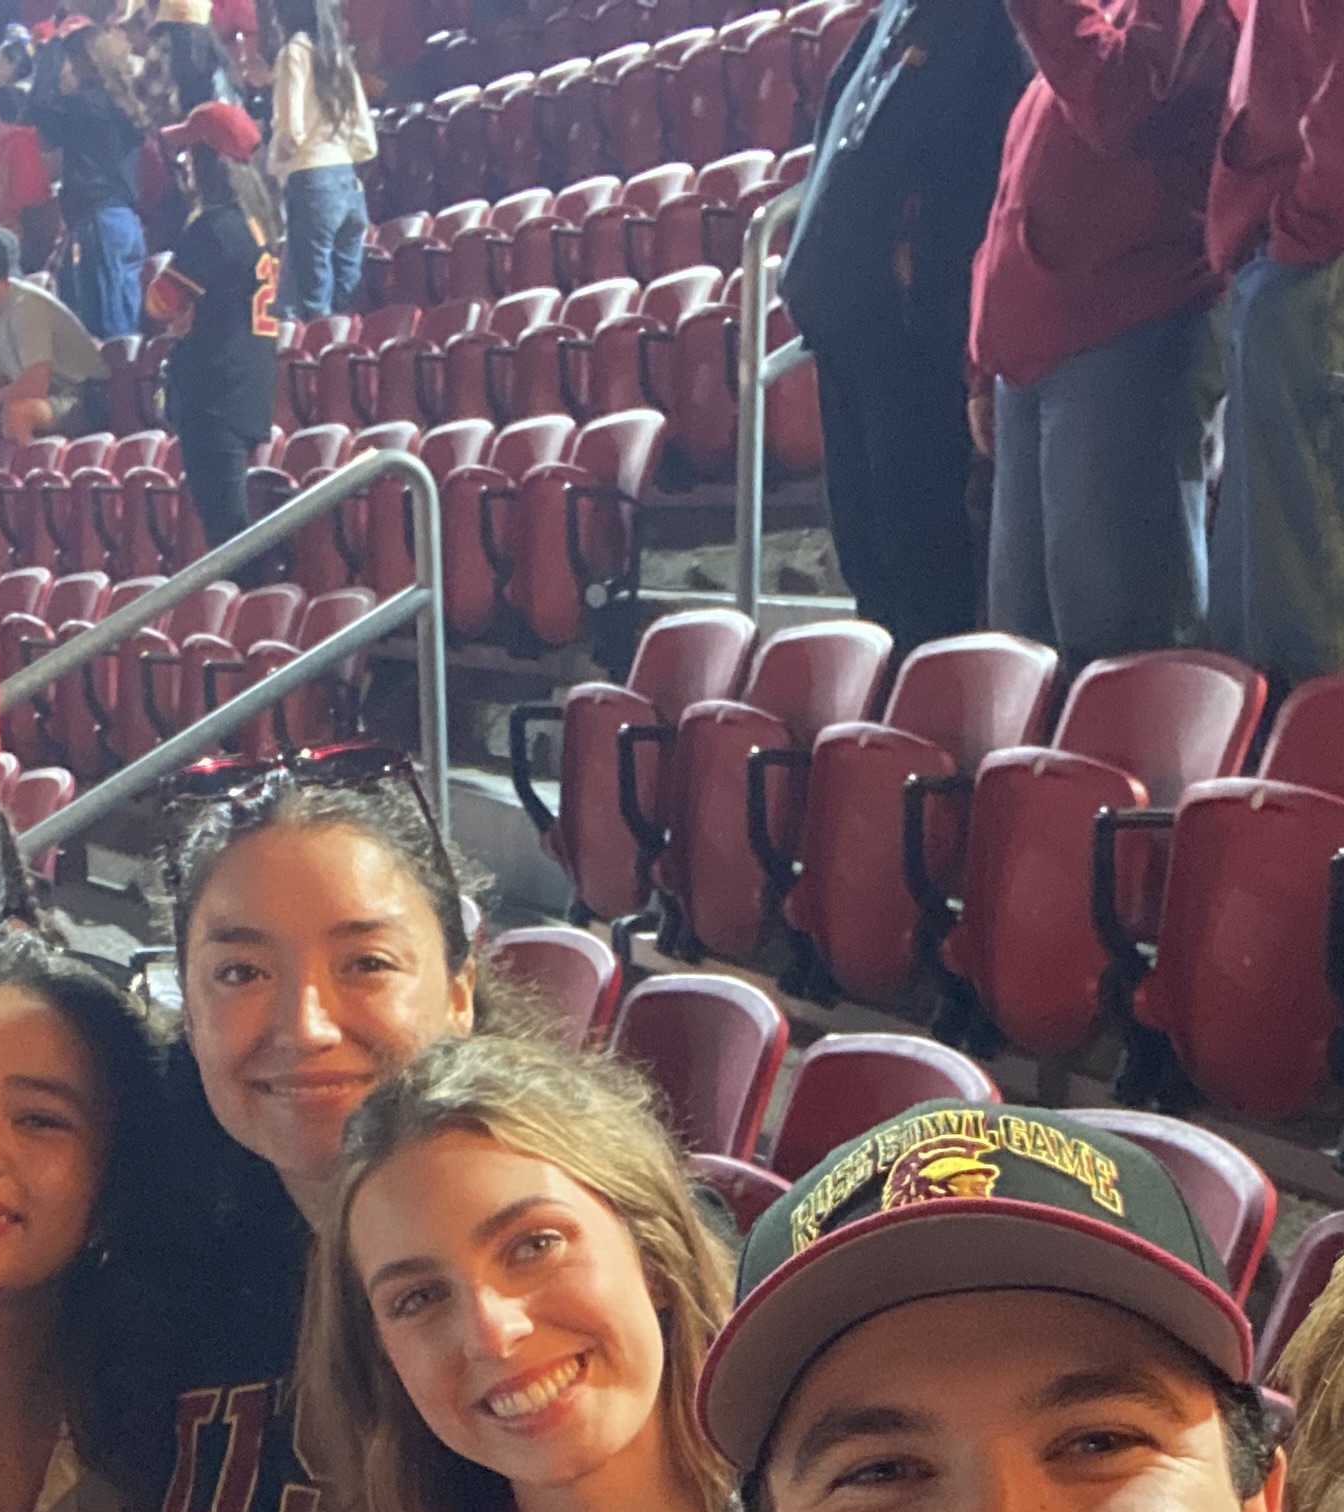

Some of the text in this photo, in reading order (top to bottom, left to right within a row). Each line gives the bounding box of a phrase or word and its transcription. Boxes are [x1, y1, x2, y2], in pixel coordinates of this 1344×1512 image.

[252, 251, 280, 338] 2
[789, 1109, 1125, 1256] ROSE BOWL GAME
